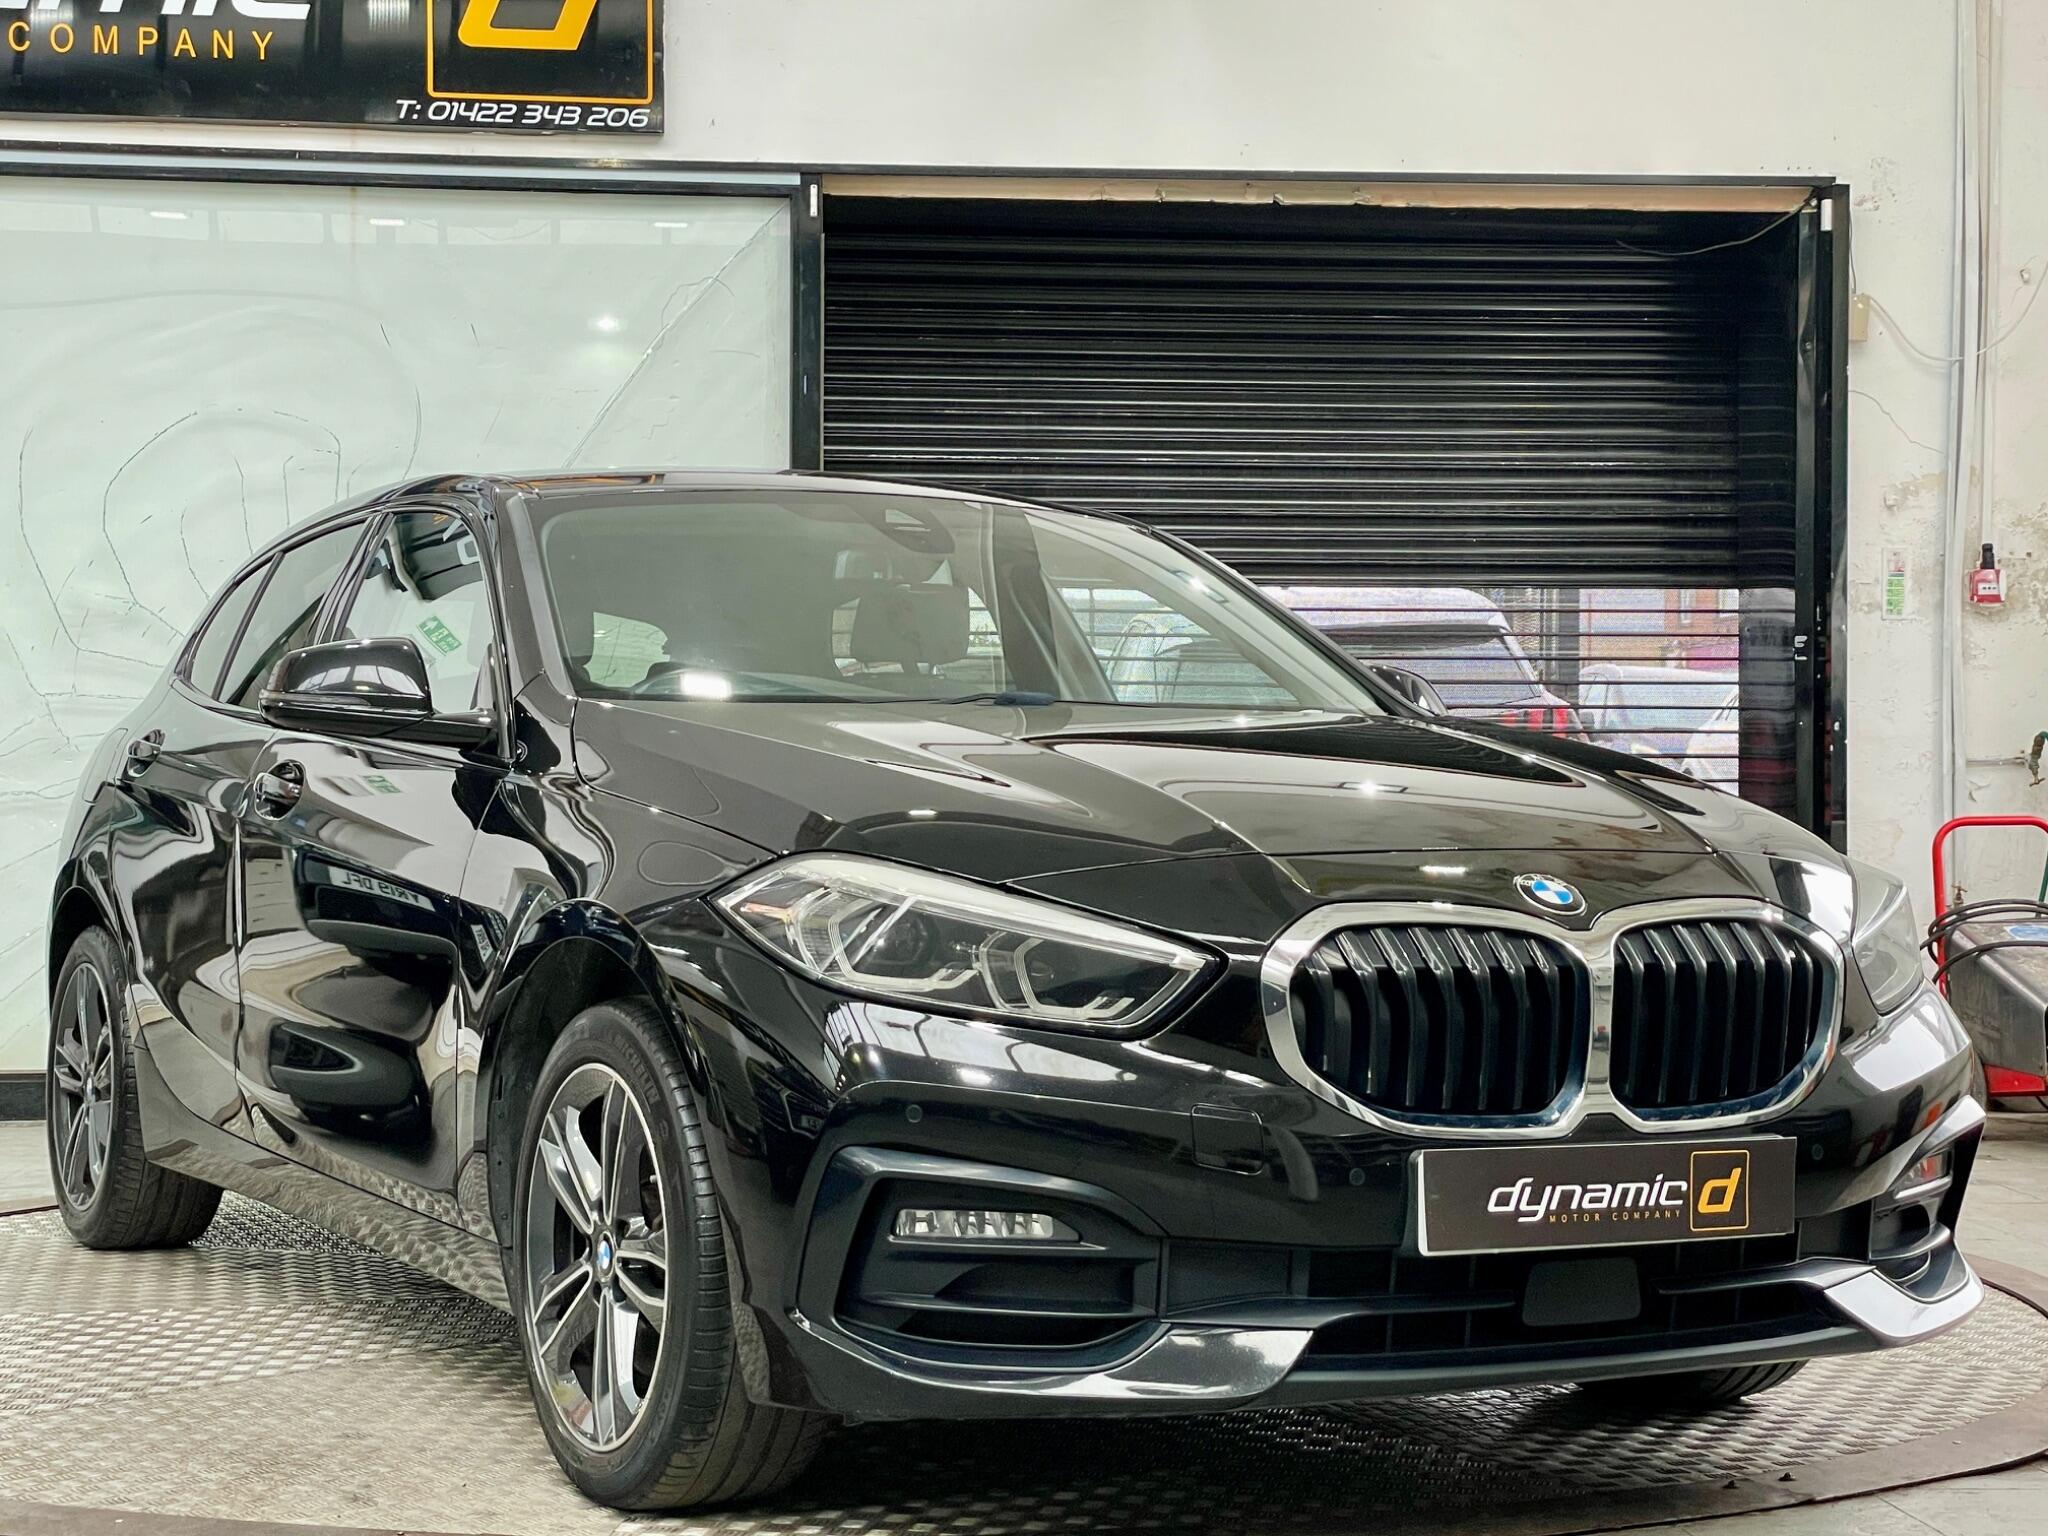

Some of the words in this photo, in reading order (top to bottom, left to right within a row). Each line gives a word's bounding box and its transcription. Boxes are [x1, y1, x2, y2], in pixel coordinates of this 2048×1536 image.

[7, 20, 274, 61] COMPANY
[396, 99, 421, 120] T:
[427, 101, 517, 123] 01422
[521, 105, 581, 126] 343
[586, 108, 649, 128] 206
[1487, 1173, 1688, 1223] dynamic
[1549, 1213, 1601, 1224] MOTOR
[1611, 1209, 1682, 1222] COMPANY
